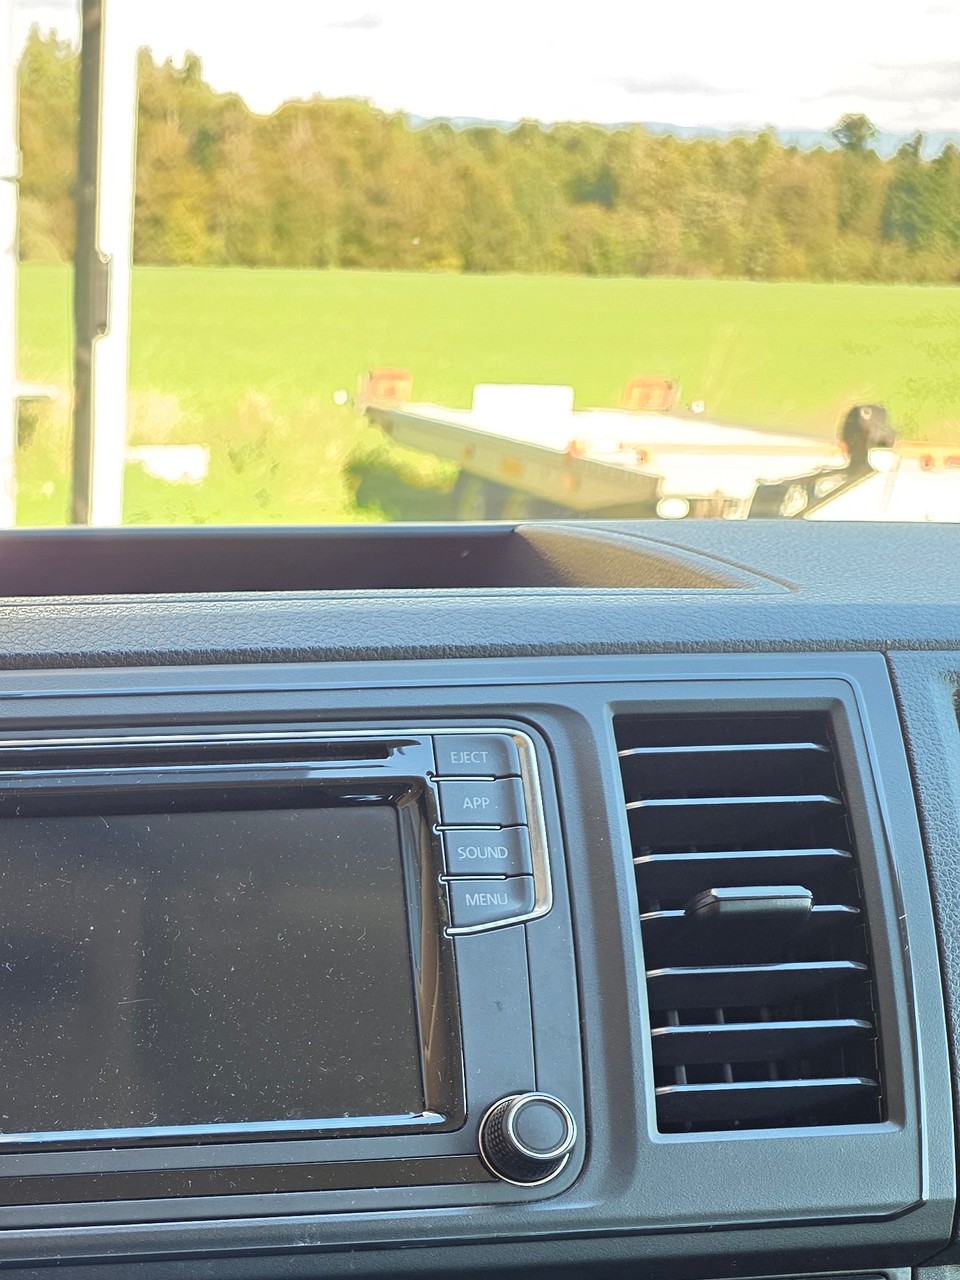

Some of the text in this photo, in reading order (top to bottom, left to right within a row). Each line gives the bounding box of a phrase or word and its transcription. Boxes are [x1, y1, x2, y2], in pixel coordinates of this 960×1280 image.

[450, 751, 488, 764] EJECT
[462, 797, 490, 809] APP
[457, 846, 508, 859] SOUND
[465, 893, 508, 906] MENU
